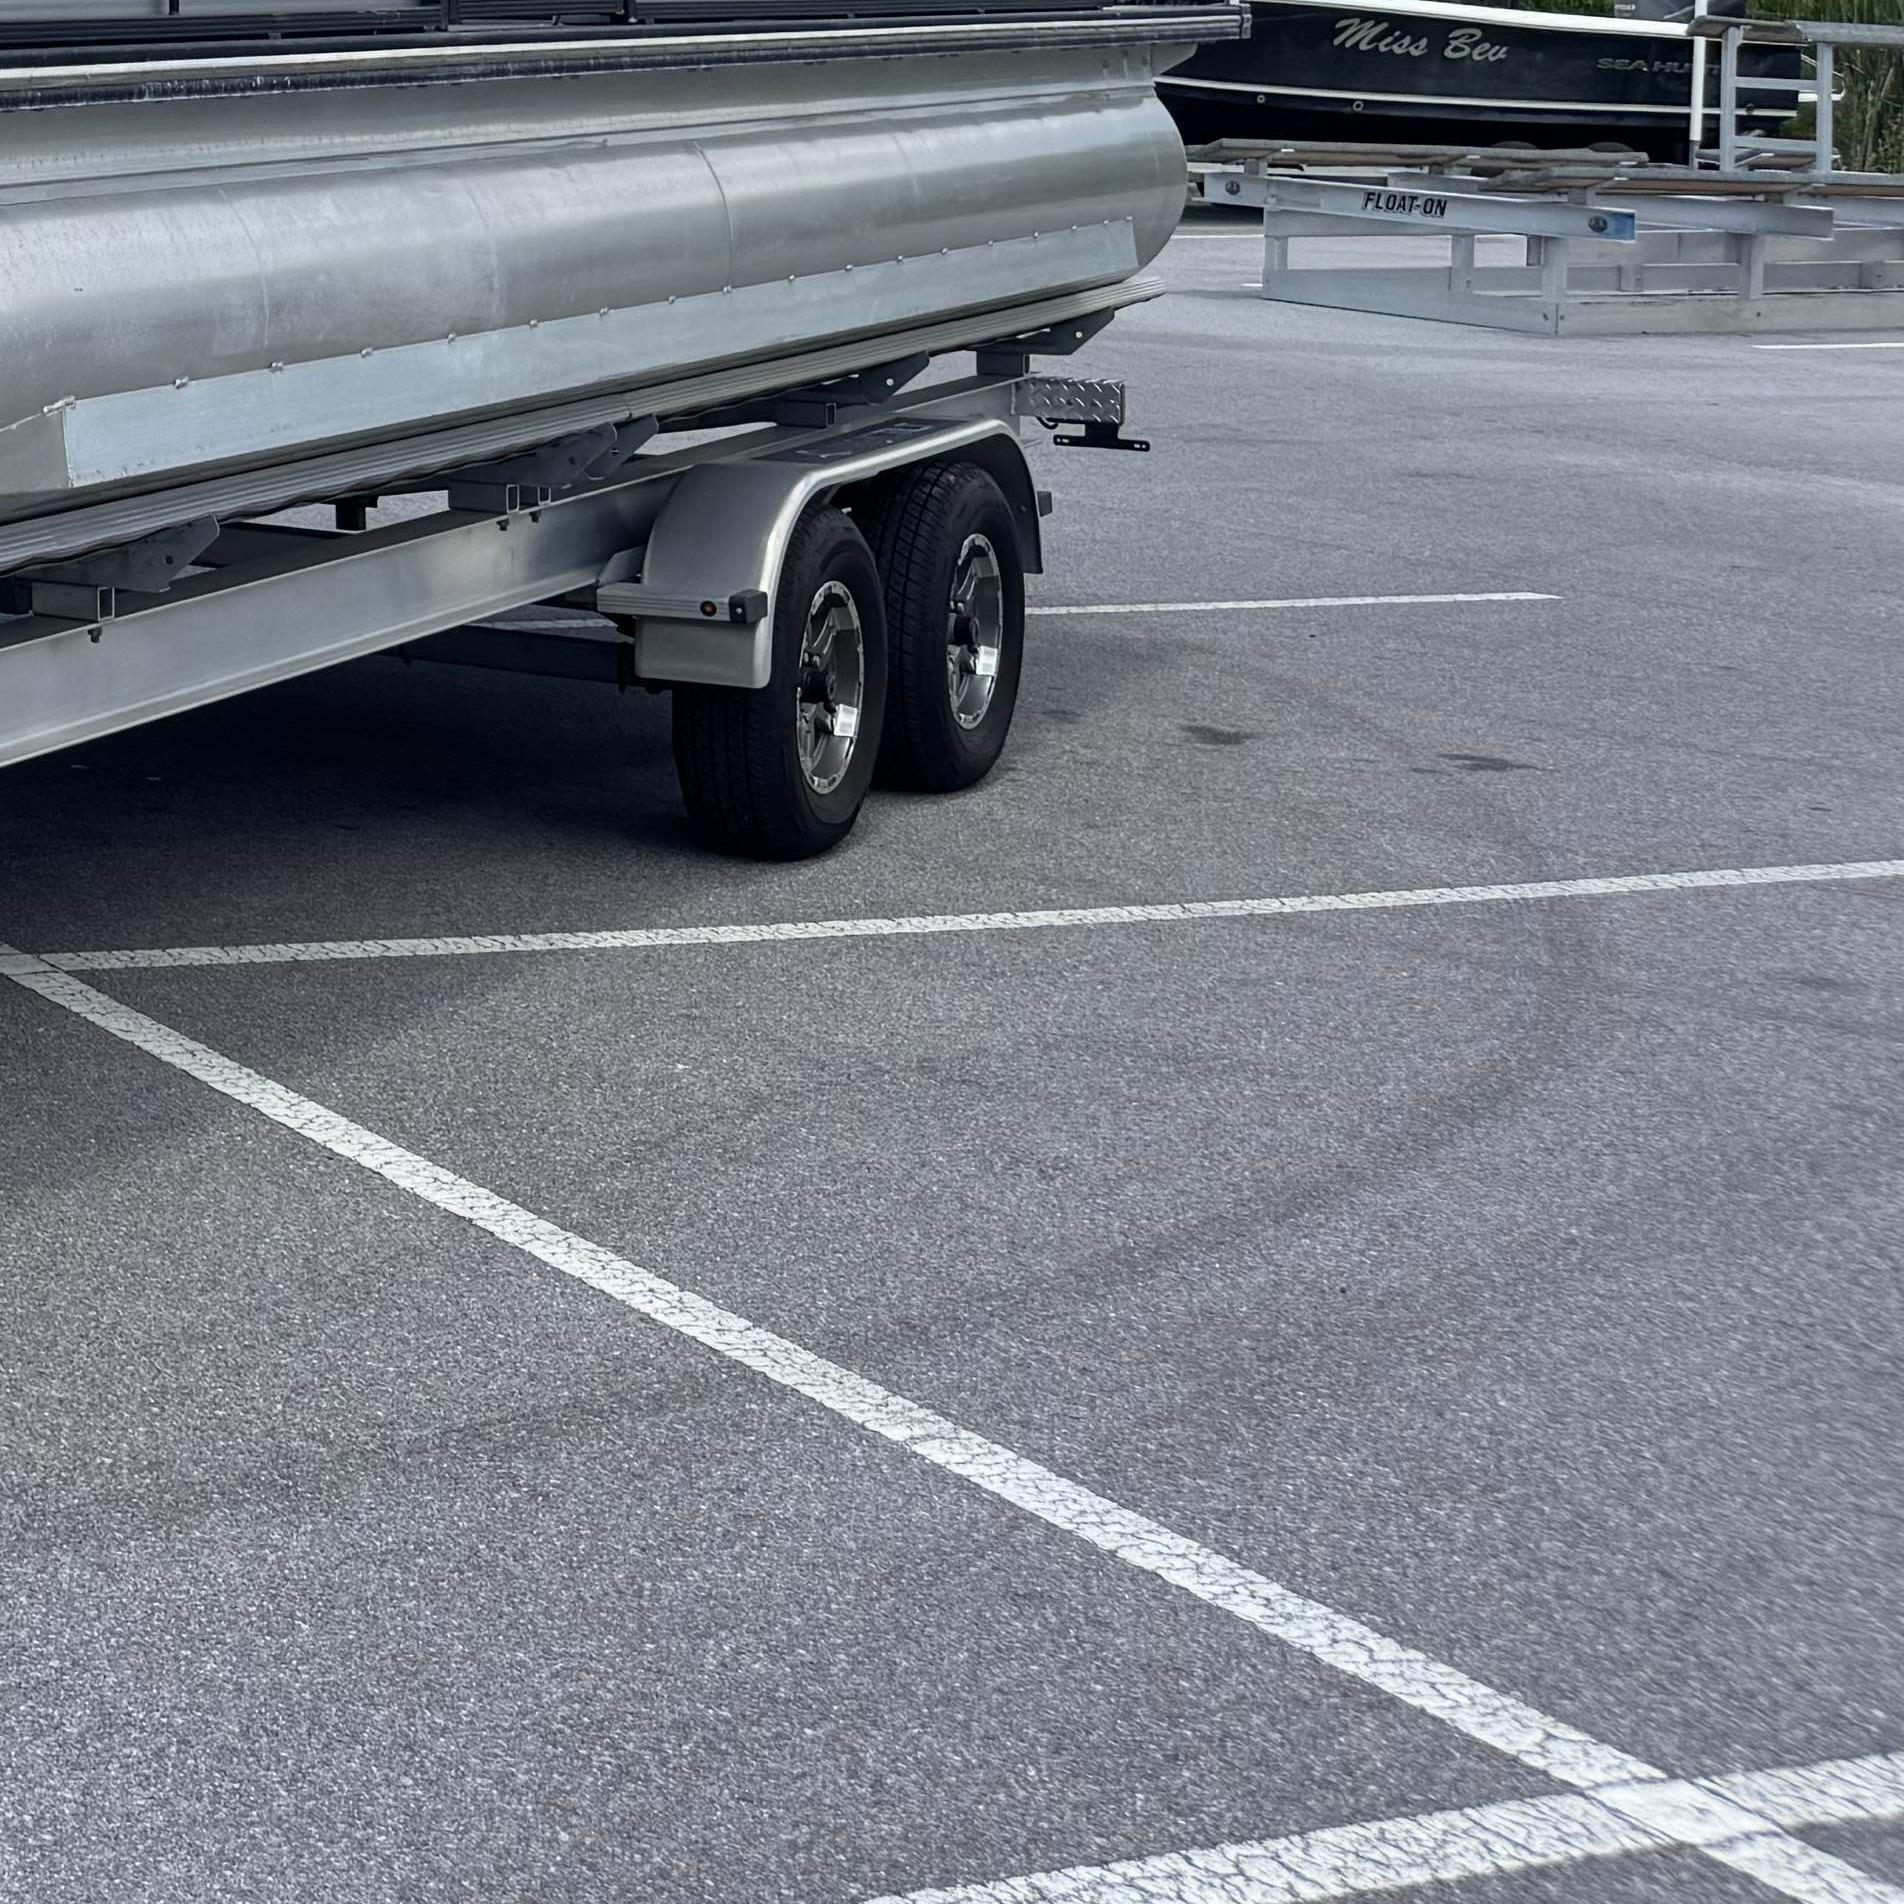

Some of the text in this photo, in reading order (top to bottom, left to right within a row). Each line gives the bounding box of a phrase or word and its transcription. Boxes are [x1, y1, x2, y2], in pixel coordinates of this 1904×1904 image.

[1332, 17, 1508, 62] Miss Bev
[1596, 58, 1722, 75] SEA HUT
[1362, 191, 1448, 218] FLOAT-ON
